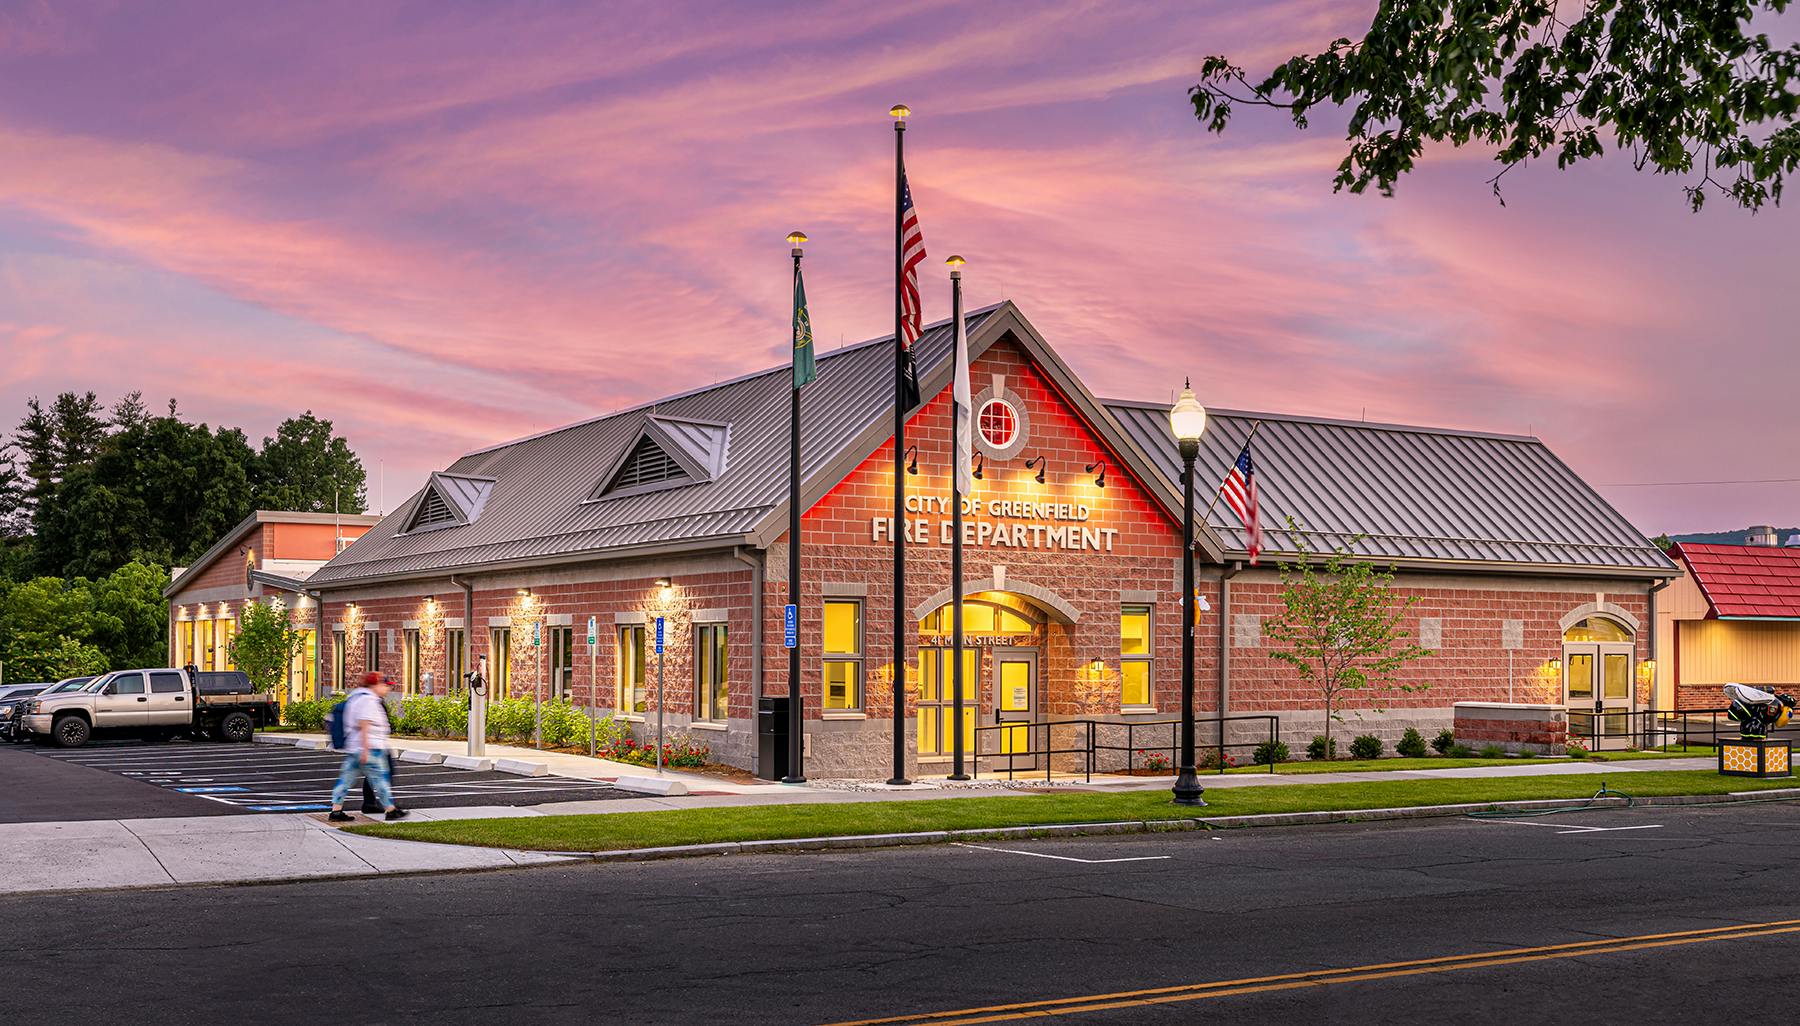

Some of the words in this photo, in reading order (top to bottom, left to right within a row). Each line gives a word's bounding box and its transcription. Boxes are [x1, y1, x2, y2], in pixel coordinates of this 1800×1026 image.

[905, 495, 950, 514] CITY
[961, 497, 981, 516] OF
[988, 500, 1089, 520] GREENFIELD
[872, 517, 929, 543] FIRE
[941, 520, 1118, 551] DEPARTMENT
[944, 635, 973, 646] MN
[976, 636, 1015, 647] STREET
